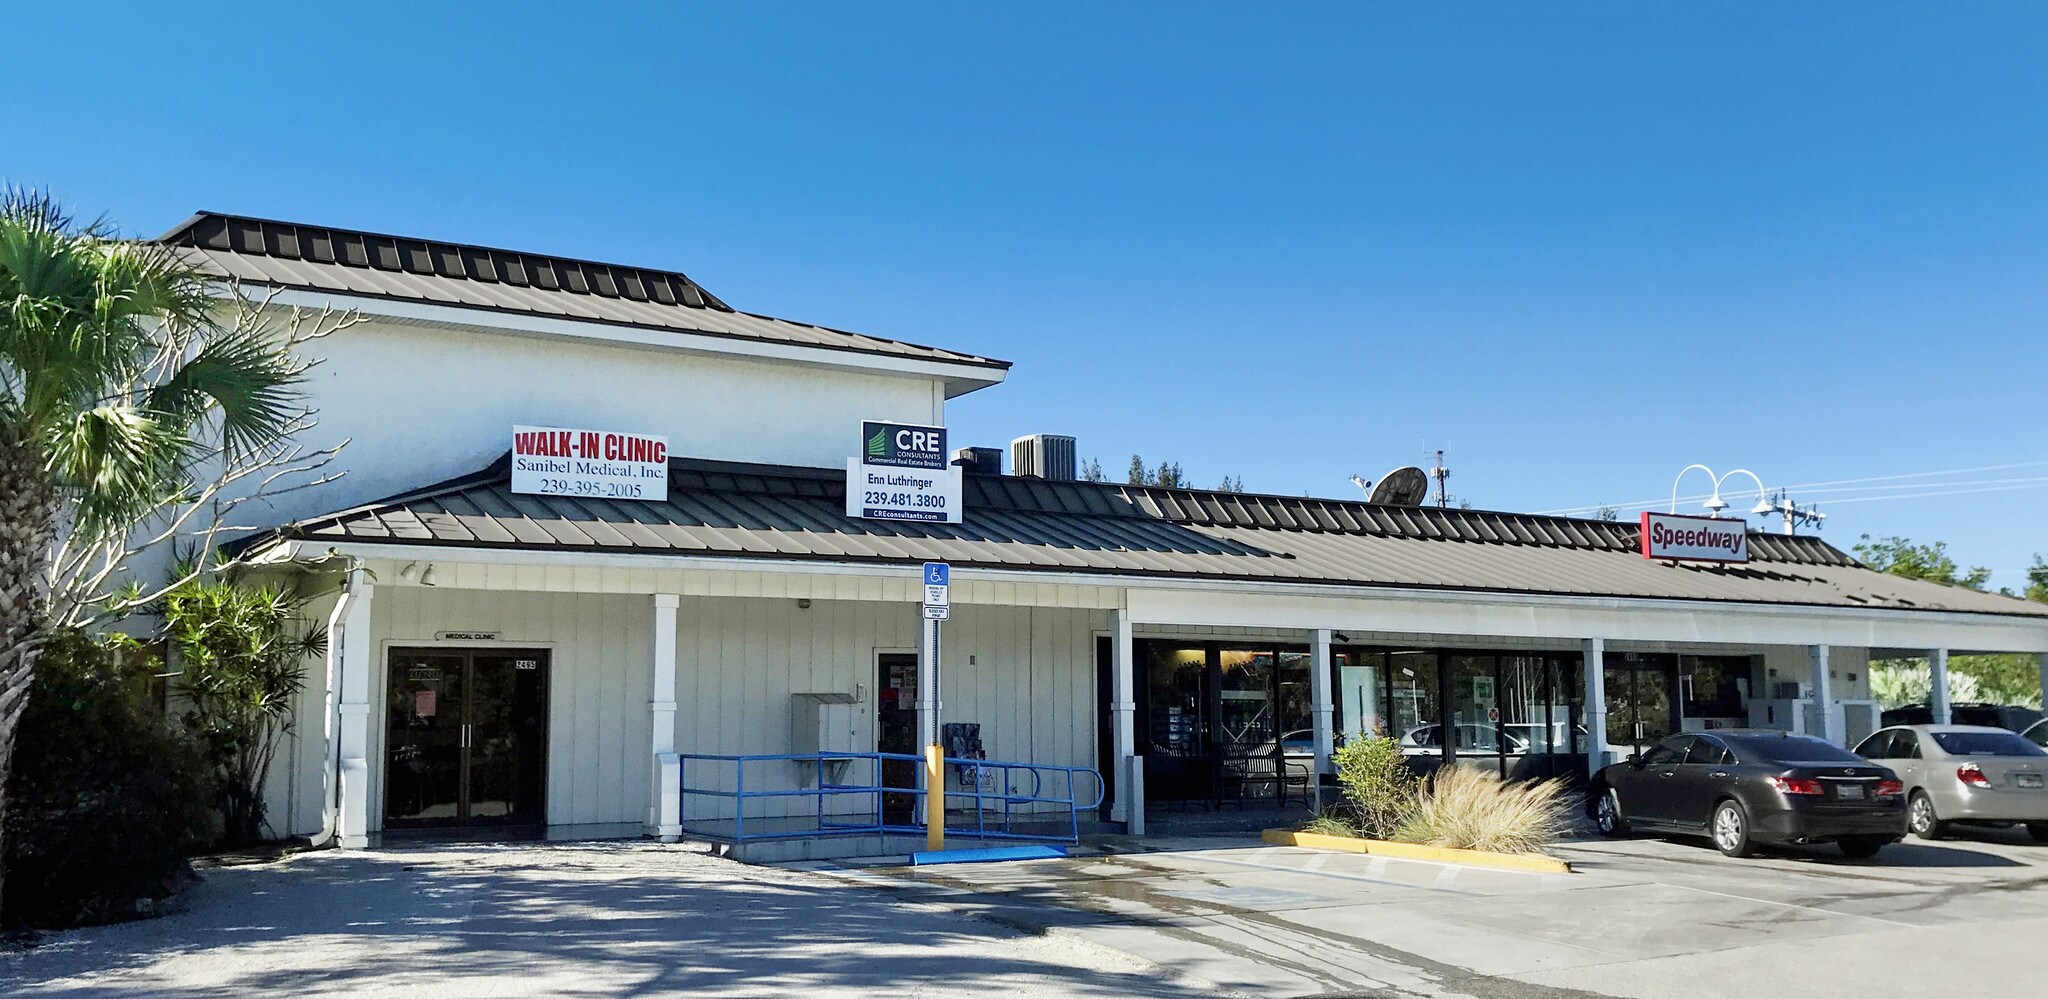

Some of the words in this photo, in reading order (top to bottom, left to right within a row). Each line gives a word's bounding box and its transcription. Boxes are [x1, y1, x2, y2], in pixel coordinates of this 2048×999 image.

[515, 431, 600, 460] WALK-IN
[604, 433, 666, 464] CLINIC
[895, 429, 940, 453] CRE
[868, 456, 897, 464] Commercial
[896, 451, 941, 460] CONSULTANTS
[517, 458, 571, 474] Sanibel
[575, 461, 637, 478] Medical,
[640, 465, 664, 479] Inc.
[540, 478, 642, 498] 239-395-2005
[868, 473, 885, 485] Enn
[887, 474, 933, 490] Luthringer
[865, 491, 946, 508] 239.481.3800
[873, 510, 938, 520] CREconsultants.com
[1652, 521, 1744, 555] Speedway
